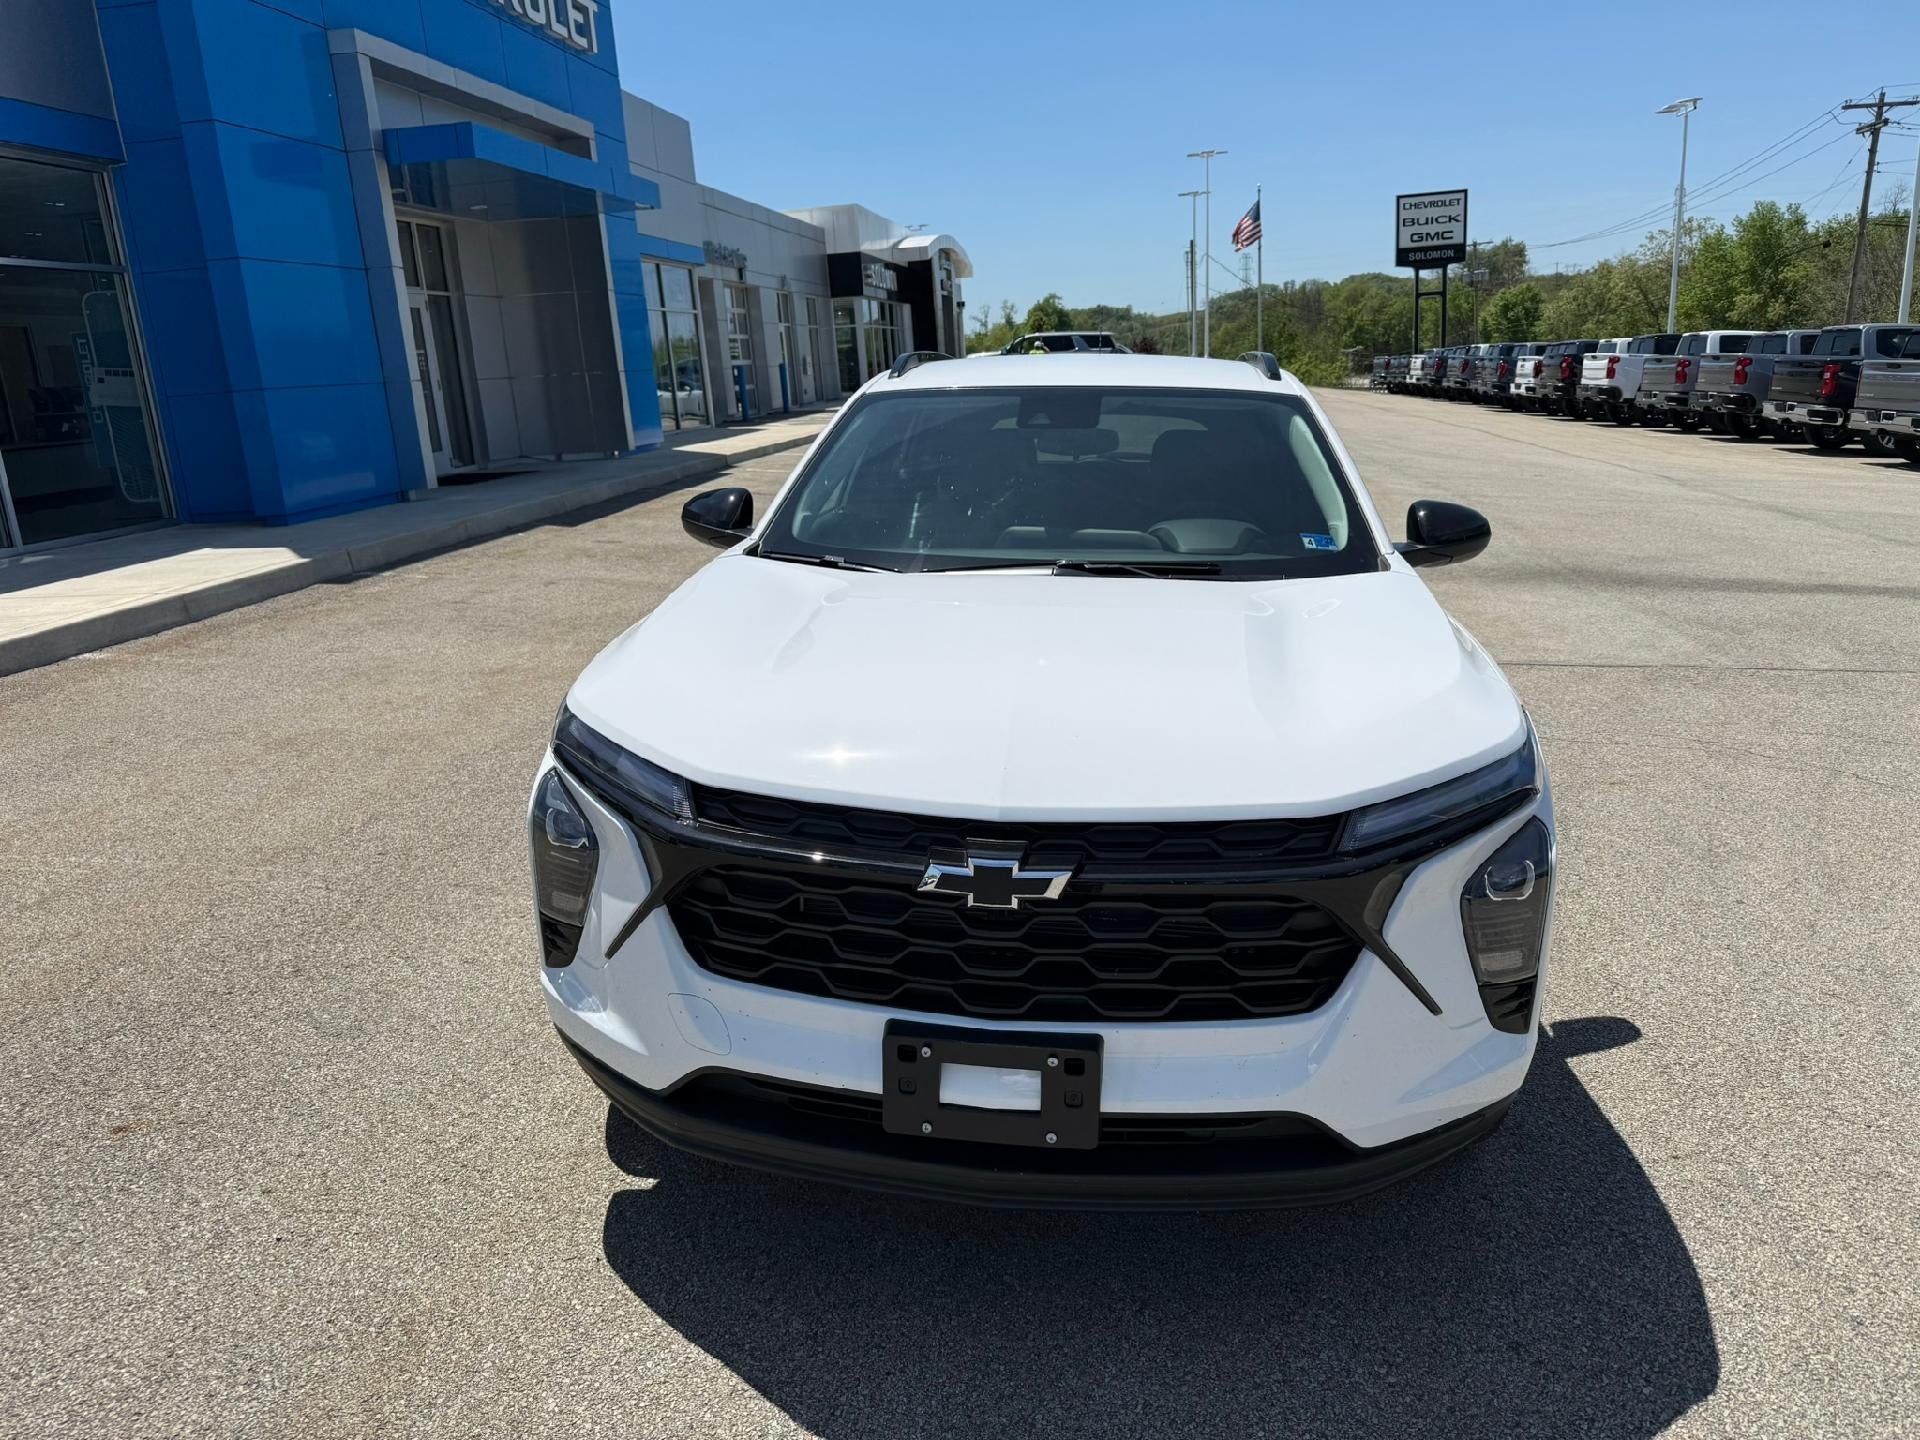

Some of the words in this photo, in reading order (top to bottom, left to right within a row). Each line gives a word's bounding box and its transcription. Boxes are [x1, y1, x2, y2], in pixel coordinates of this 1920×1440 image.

[494, 0, 598, 53] OLET
[1402, 198, 1462, 210] CHEVROLET
[1402, 214, 1462, 227] BUICK
[1410, 231, 1454, 243] GMC
[1408, 249, 1455, 260] SOLOMON
